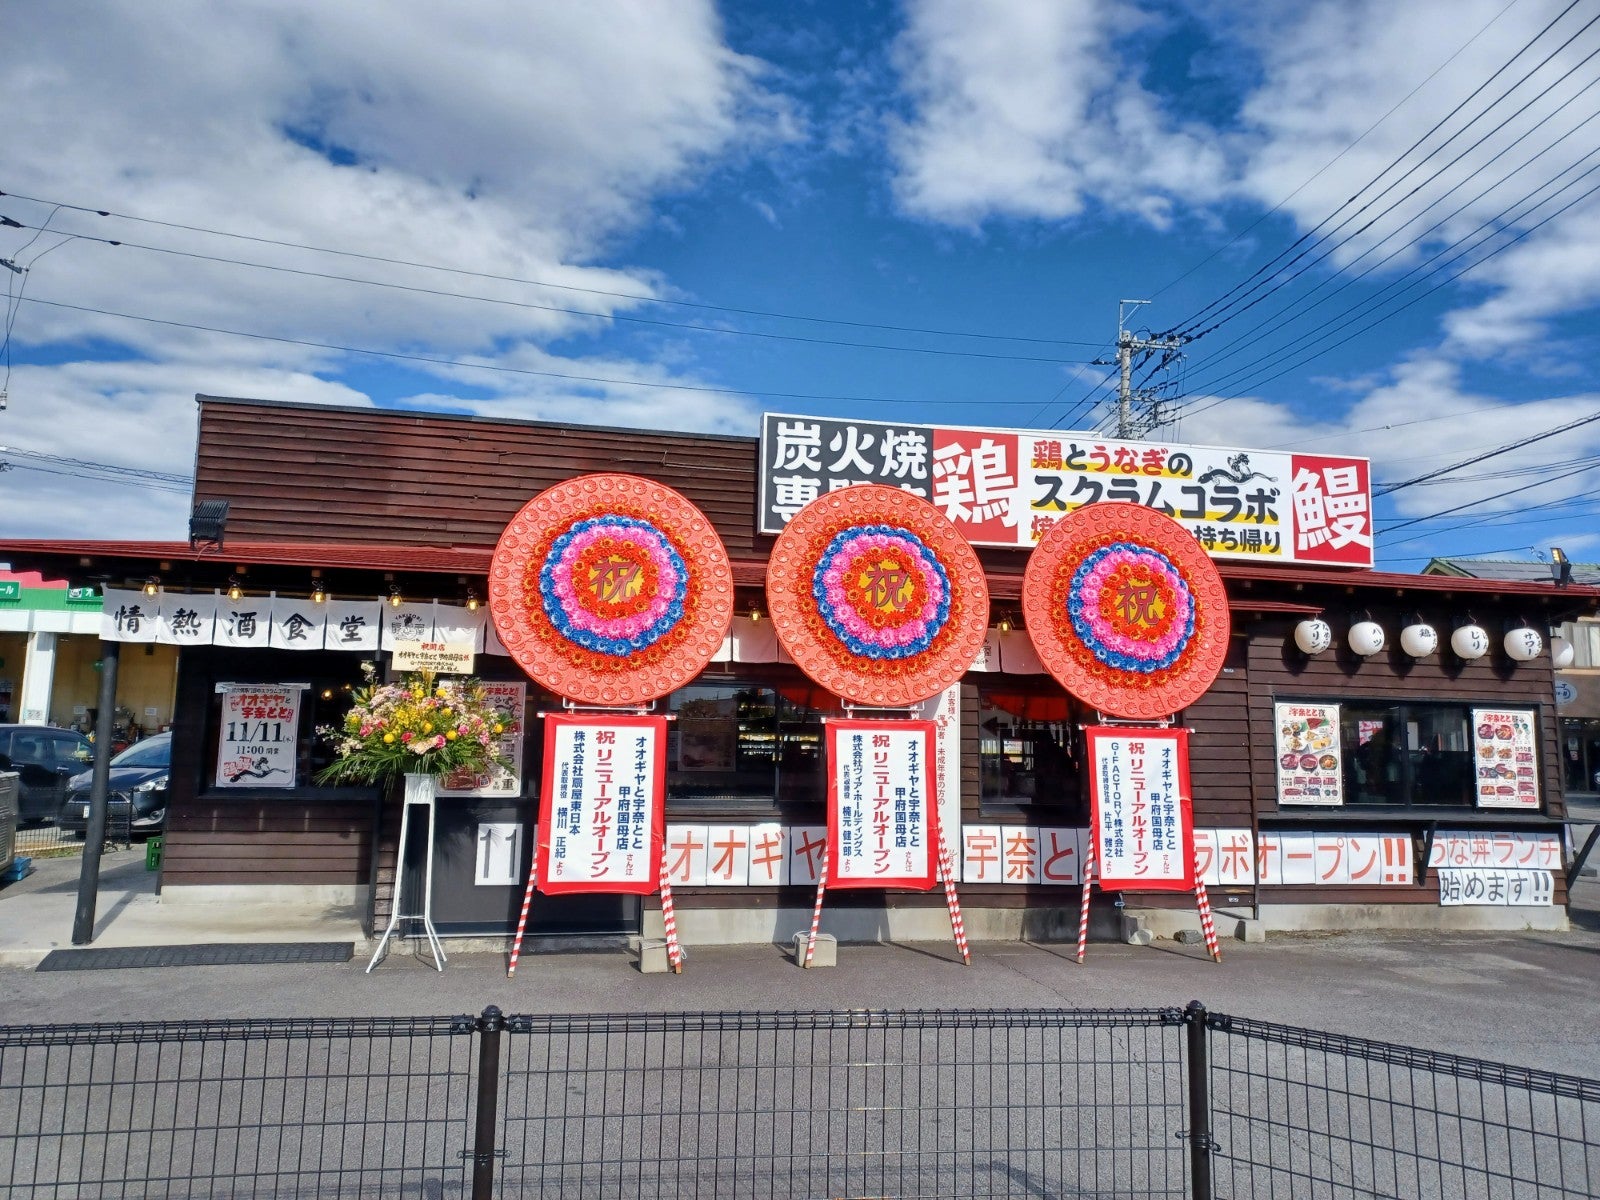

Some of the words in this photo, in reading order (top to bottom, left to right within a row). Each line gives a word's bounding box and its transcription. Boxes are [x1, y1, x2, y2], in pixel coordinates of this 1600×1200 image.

[773, 422, 928, 479] 炭火焼
[1033, 440, 1193, 476] 鶏とうなぎの
[933, 438, 1018, 528] 鶏
[1032, 475, 1281, 524] スクラムコラボ
[1292, 465, 1371, 550] 鰻
[1186, 525, 1280, 553] 持ち帰り
[589, 557, 641, 603] 祝
[865, 562, 910, 610] 祝
[1117, 583, 1160, 626] 祝
[948, 690, 956, 722] お客様へ
[226, 721, 283, 743] 11/11
[236, 746, 264, 755] 11:00
[595, 731, 616, 745] 祝
[872, 734, 890, 748] 祝
[1128, 742, 1145, 755] 祝
[569, 731, 585, 836] 株式会社扇屋東日本
[632, 736, 647, 850] オオギヤと宇奈とと
[908, 740, 921, 848] オオギヤと宇奈とと
[1111, 742, 1124, 858] G-FACTORY株式会社
[1162, 748, 1176, 851] オオギヤと宇奈とと
[590, 749, 614, 879] リニューアルオープン
[616, 786, 631, 851] 甲府国母店
[872, 752, 891, 875] リニューアルオープン
[895, 787, 907, 848] 甲府国母店
[1130, 758, 1149, 876] リニューアルオープン
[1150, 792, 1163, 851] 甲府国母店
[479, 828, 517, 879] 11
[556, 861, 564, 876] より
[669, 829, 827, 882] オオギヤ
[844, 859, 851, 873] より
[1433, 834, 1558, 865] うな丼ランチ
[1441, 871, 1549, 902] 始めます!!
